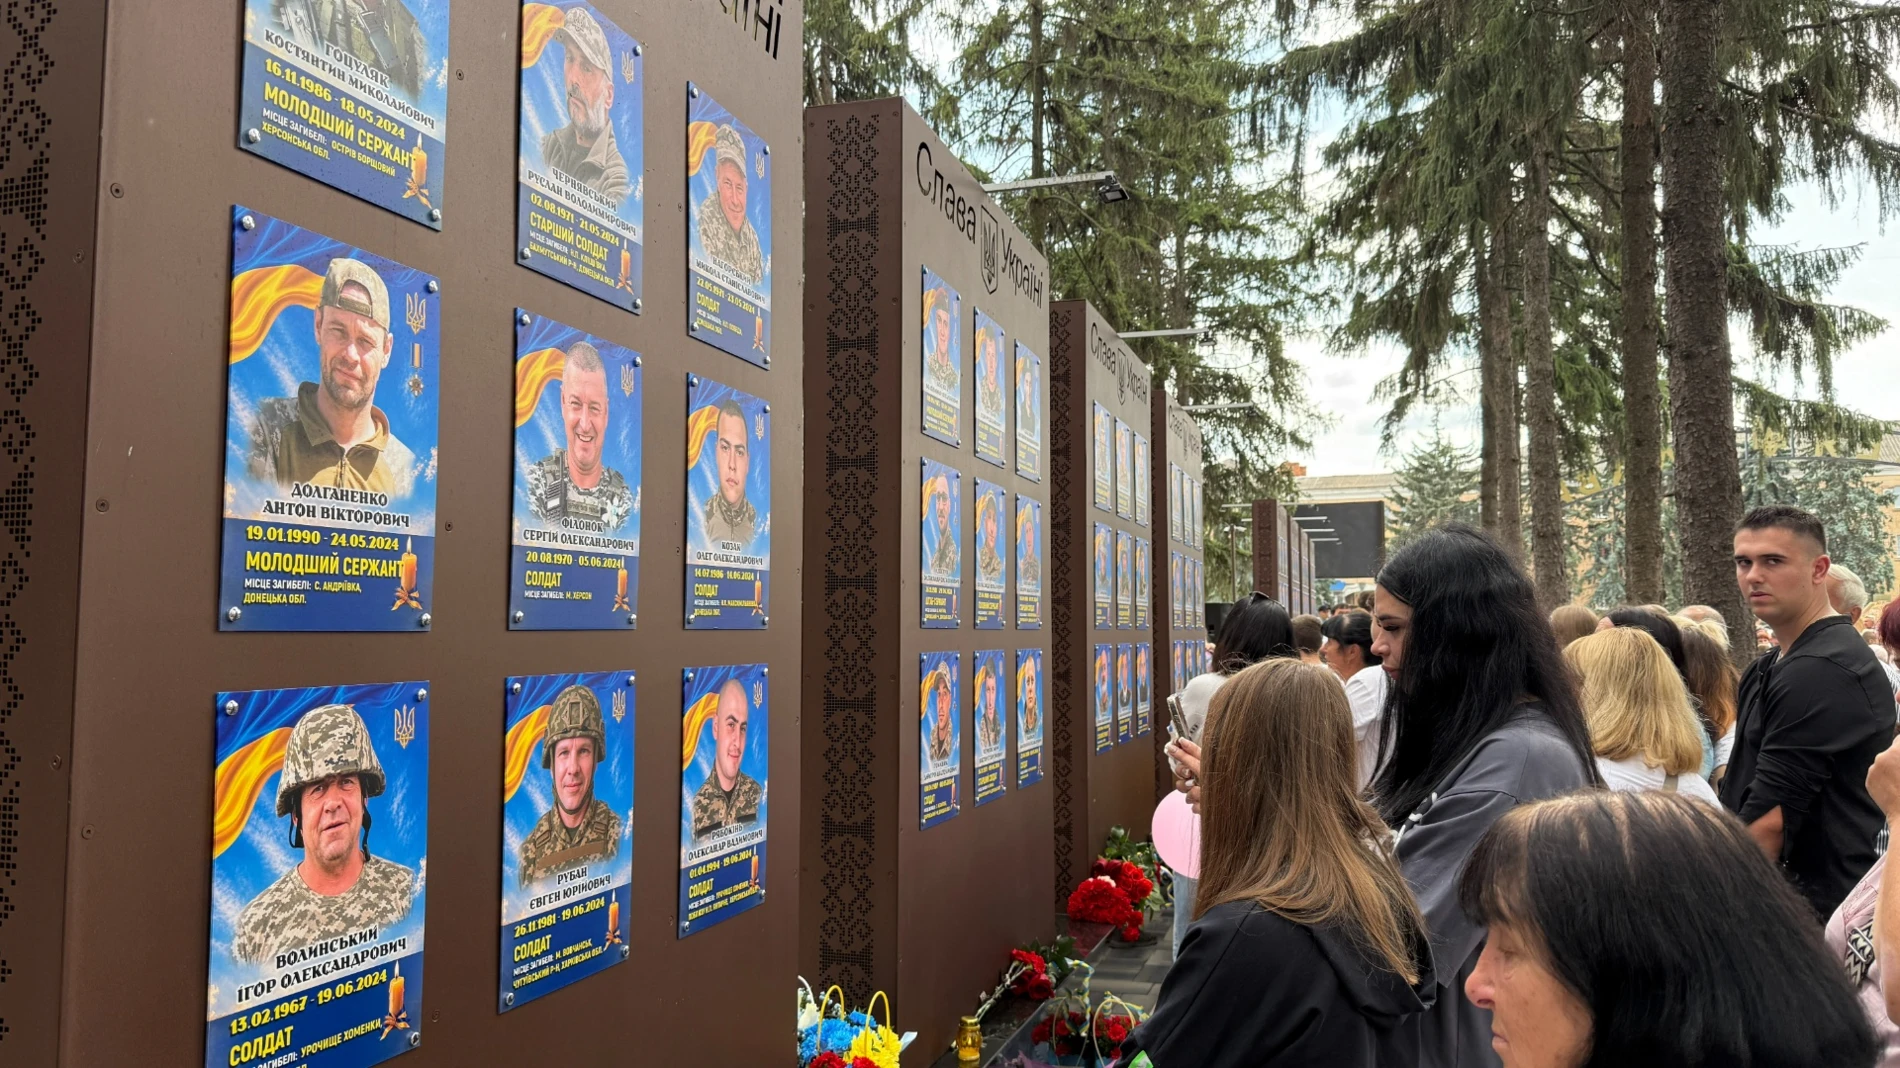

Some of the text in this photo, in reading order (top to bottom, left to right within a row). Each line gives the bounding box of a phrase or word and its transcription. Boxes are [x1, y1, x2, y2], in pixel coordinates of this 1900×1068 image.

[265, 29, 434, 130] КОСТЯНТИН МИКОЛАЙОВИЧ
[325, 43, 390, 88] ГОЦУЛЯК
[265, 58, 332, 102] 16.11.1986
[340, 98, 406, 140] 18.05.2024
[262, 121, 330, 160] ХЕРСОНСЬКА ОБЛ.
[263, 108, 396, 176] МІСЦЕ ЗАГИБЕЛІ: ОСТРІВ БОРЩОВИЙ
[264, 83, 416, 170] МОЛОДШИЙ СЕРЖАНТ
[527, 170, 636, 236] РУСЛАН ВОЛОДИМИРОВИЧ
[552, 168, 616, 212] ЧЕРНЯВСЬКИЙ
[530, 194, 574, 224] 02.08.1971
[580, 218, 620, 246] 21.05.2024
[530, 212, 608, 261] СТАРШИЙ СОЛДАТ
[916, 142, 1044, 309] Слава Україні
[1091, 322, 1116, 376] Слава
[262, 500, 410, 528] АНТОН ВІКТОРОВИЧ
[292, 482, 388, 506] ДОЛГАНЕНКО
[246, 525, 320, 544] 19.01.1990
[330, 532, 399, 550] 24.05.2024
[524, 530, 634, 550] СЕРГІЙ ОЛЕКСАНДРОВИЧ
[562, 517, 604, 532] ФІЛОНОК
[246, 551, 404, 578] МОЛОДШИЙ СЕРЖАНТ
[525, 570, 562, 588] СОЛДАТ
[526, 551, 572, 565] 20.08.1970
[578, 556, 621, 569] 05.06.2024
[244, 578, 362, 593] МІСЦЕ ЗАГИБЕЛІ: С. АНДРІЇВКА,
[244, 592, 306, 605] ДОНЕЦЬКА ОБЛ.
[530, 875, 611, 910] ЄВГЕН ЮРІЙОВИЧ
[557, 866, 587, 885] РУБАН
[514, 914, 556, 938] 26.11.1981
[562, 897, 605, 921] 19.06.2024
[276, 926, 378, 968] ВОЛИНСЬКИЙ
[514, 934, 552, 962] СОЛДАТ
[238, 938, 407, 1003] ІГОР ОЛЕКСАНДРОВИЧ
[230, 996, 308, 1034] 13.02.1967
[318, 969, 387, 1005] 19.06.2024
[230, 1026, 294, 1066] СОЛДАТ
[301, 1035, 342, 1058] УРОЧИЩЕ
[344, 1018, 382, 1040] ХОМЕНКИ,
